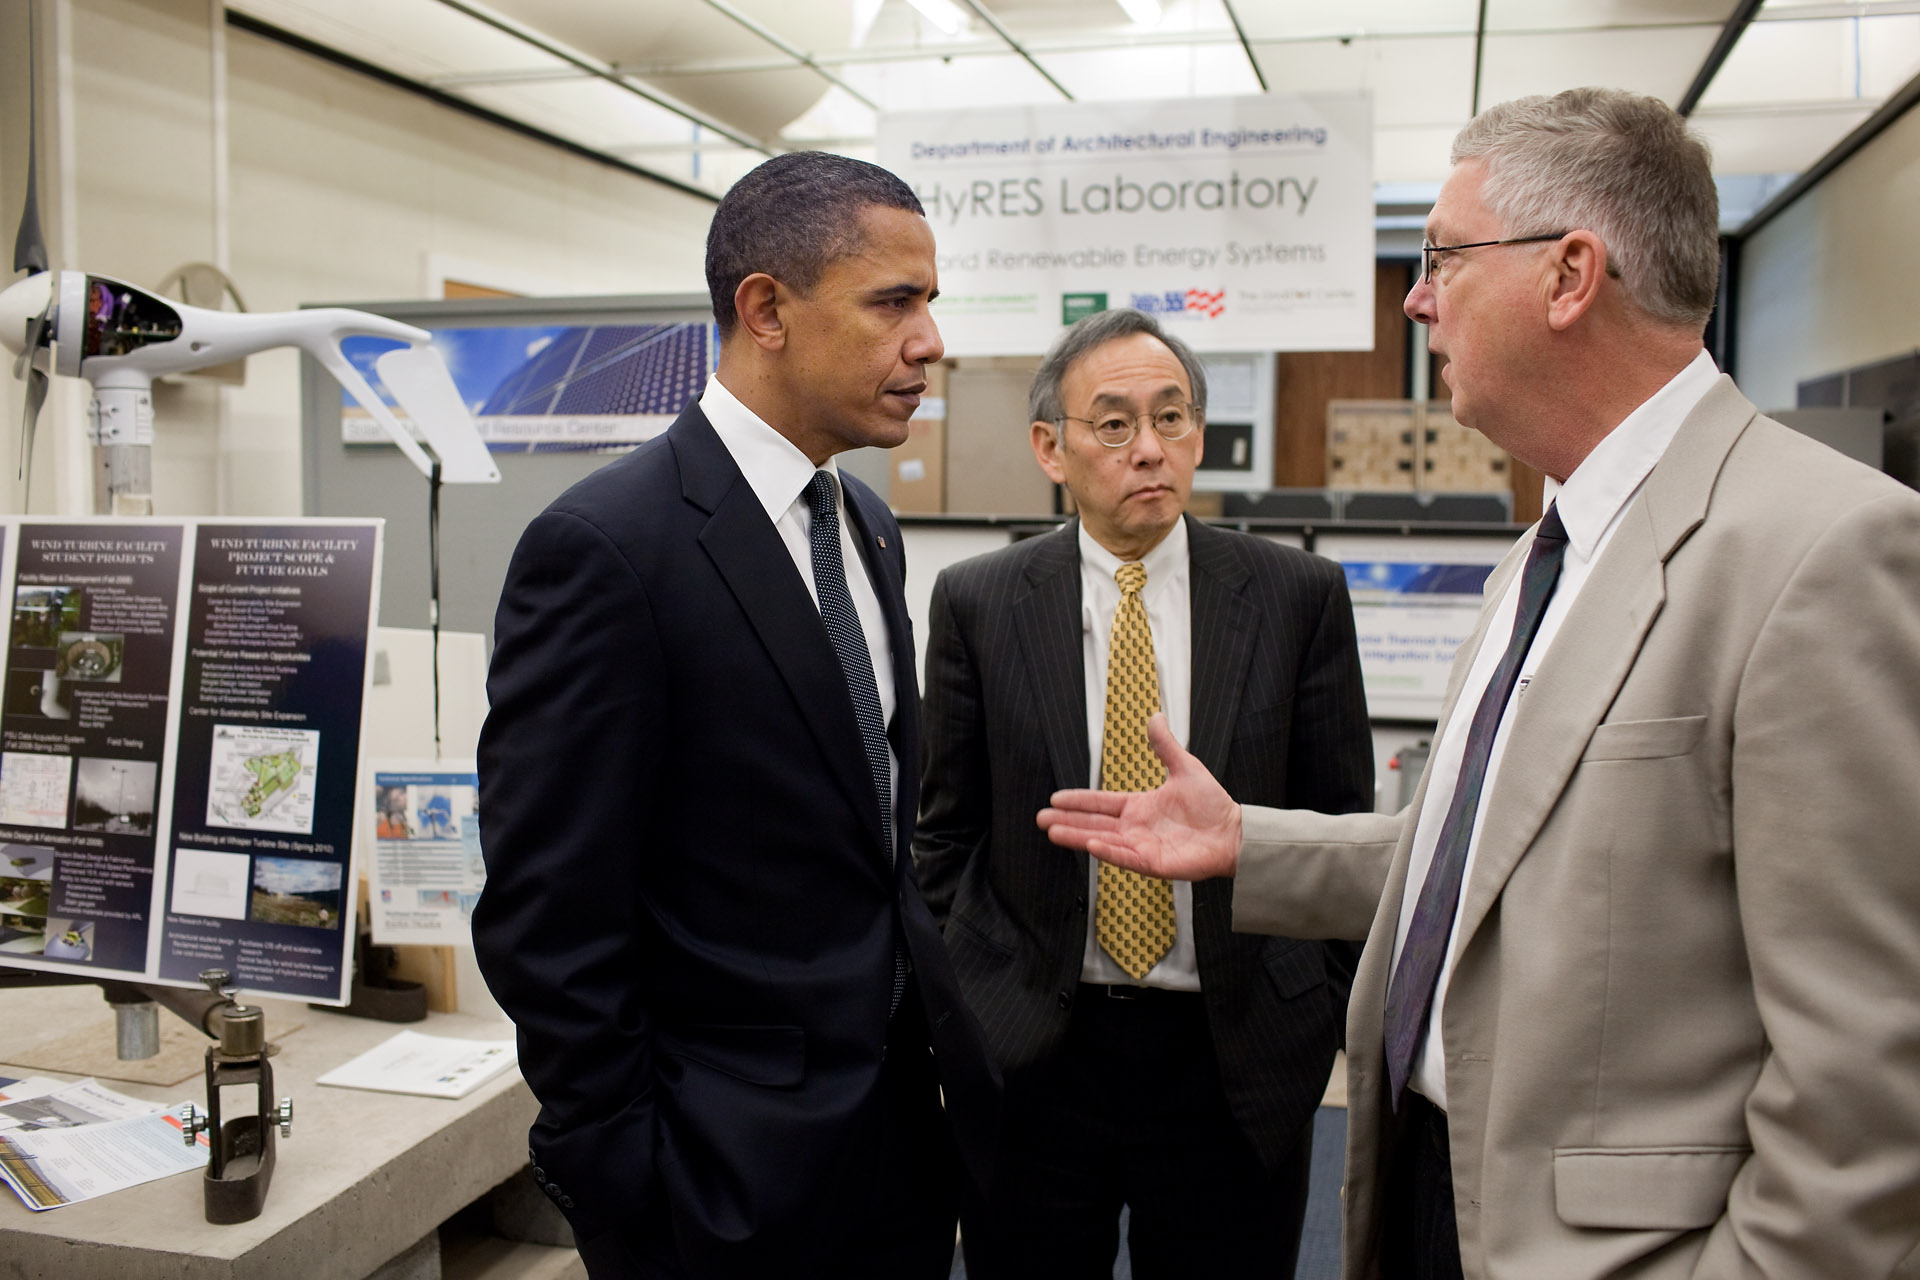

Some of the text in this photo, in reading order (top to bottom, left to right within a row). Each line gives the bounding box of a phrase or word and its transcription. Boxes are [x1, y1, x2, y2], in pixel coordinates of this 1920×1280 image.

[911, 124, 1327, 160] Department of Architectural Engineering
[1060, 170, 1318, 216] Laboratory
[986, 245, 1127, 270] Renewable
[1134, 244, 1220, 270] Energy
[1225, 240, 1327, 268] Systems
[566, 419, 615, 434] Center
[32, 540, 168, 551] WIND TURBINE FACILITY
[211, 538, 358, 550] WIND TURBINE FACILITY
[42, 552, 154, 564] STUDENT PROJECTS
[228, 552, 282, 563] PROJECT
[284, 552, 323, 564] SCOPE
[236, 565, 328, 577] FUTURE GOALS
